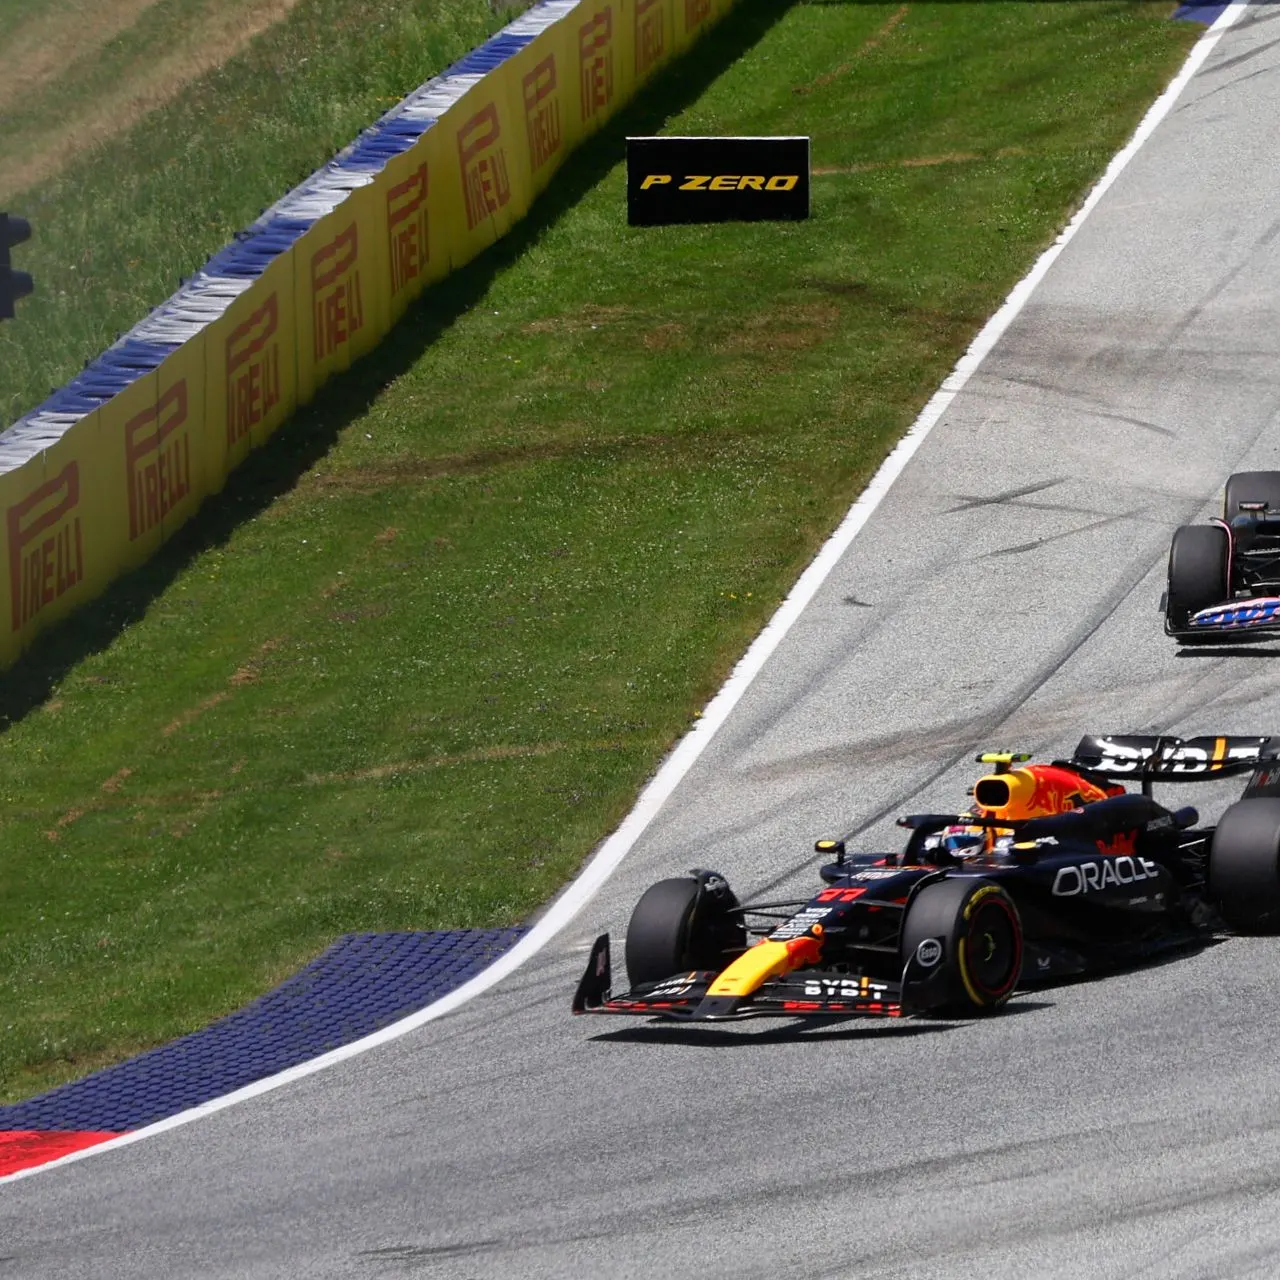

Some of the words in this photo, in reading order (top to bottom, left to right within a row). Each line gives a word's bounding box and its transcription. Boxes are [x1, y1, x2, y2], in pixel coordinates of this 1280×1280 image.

[640, 175, 673, 190] P
[678, 175, 799, 191] ZERO
[125, 376, 192, 543] PIRELLI
[7, 459, 85, 633] PIRELLI
[1052, 856, 1159, 897] ORACLE
